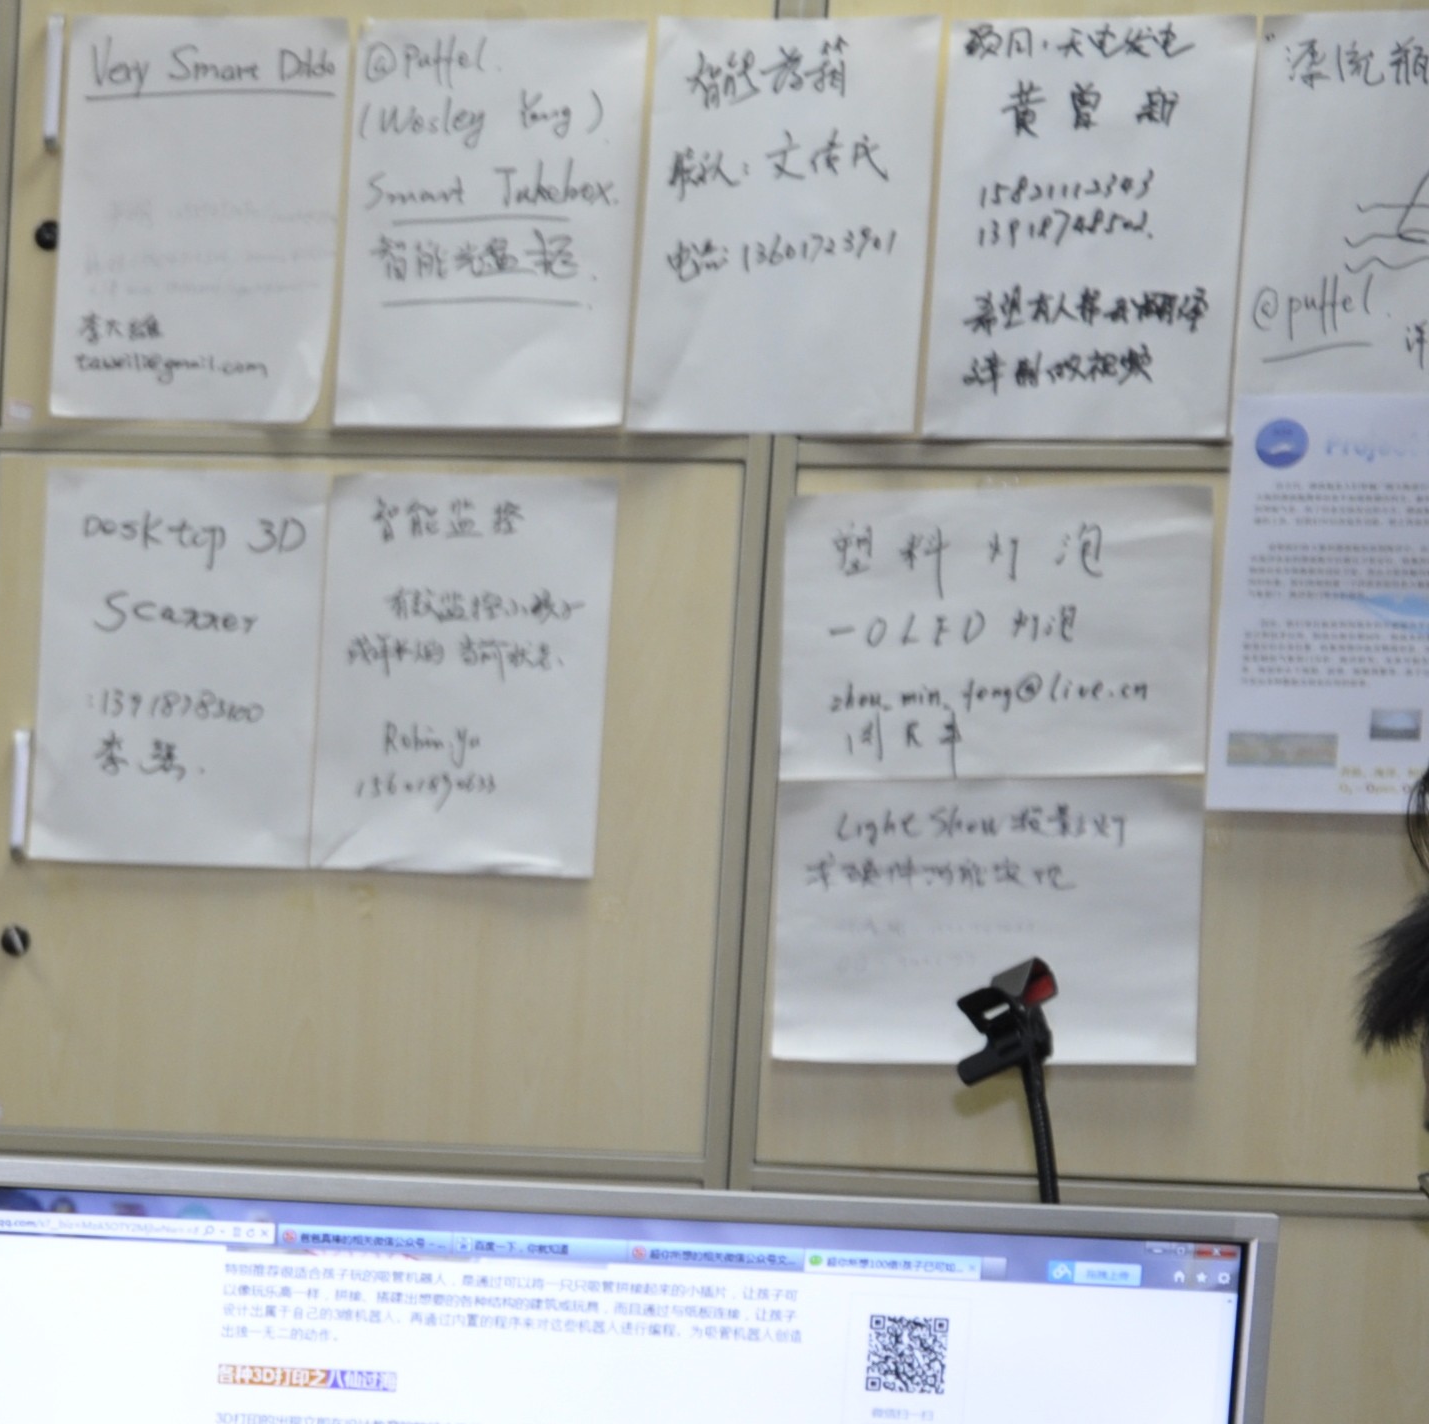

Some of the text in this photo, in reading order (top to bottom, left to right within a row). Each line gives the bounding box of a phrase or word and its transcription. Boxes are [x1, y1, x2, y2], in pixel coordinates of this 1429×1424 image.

[91, 35, 150, 95] Very
[168, 44, 260, 84] Smart
[247, 516, 308, 555] 3D
